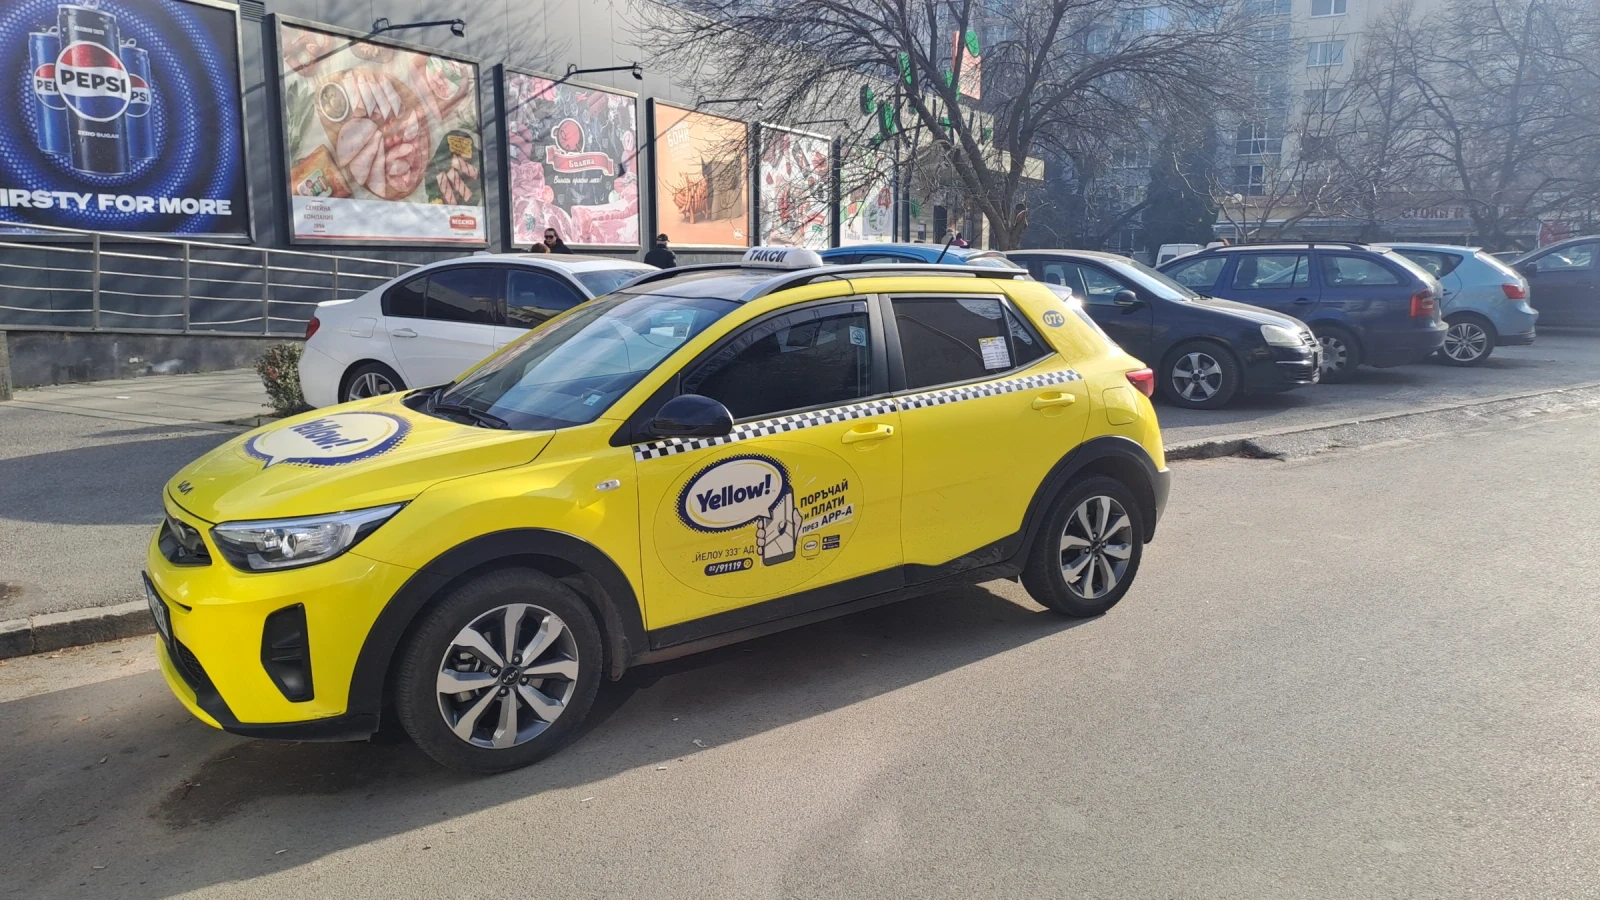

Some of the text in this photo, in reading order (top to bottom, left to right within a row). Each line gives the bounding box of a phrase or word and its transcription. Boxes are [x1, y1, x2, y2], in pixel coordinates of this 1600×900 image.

[60, 69, 127, 94] PEPSI
[131, 91, 150, 103] PSI
[77, 129, 119, 140] ZERO SUGAR
[0, 188, 232, 215] IRSTY FOR MORE
[304, 204, 331, 212] СЕМЕЙНА
[303, 213, 334, 221] КОМПАНИЯ
[749, 249, 788, 263] ТАКСИ
[1043, 312, 1064, 325] 073
[289, 418, 369, 450] Yellow!
[696, 473, 772, 513] Yellow!
[800, 479, 849, 508] ПОРЪЧАЙ
[811, 495, 845, 518] ПЛАТИ
[802, 521, 819, 534] ПРЕЗ
[743, 545, 755, 556] АД
[708, 560, 742, 574] 02/91119
